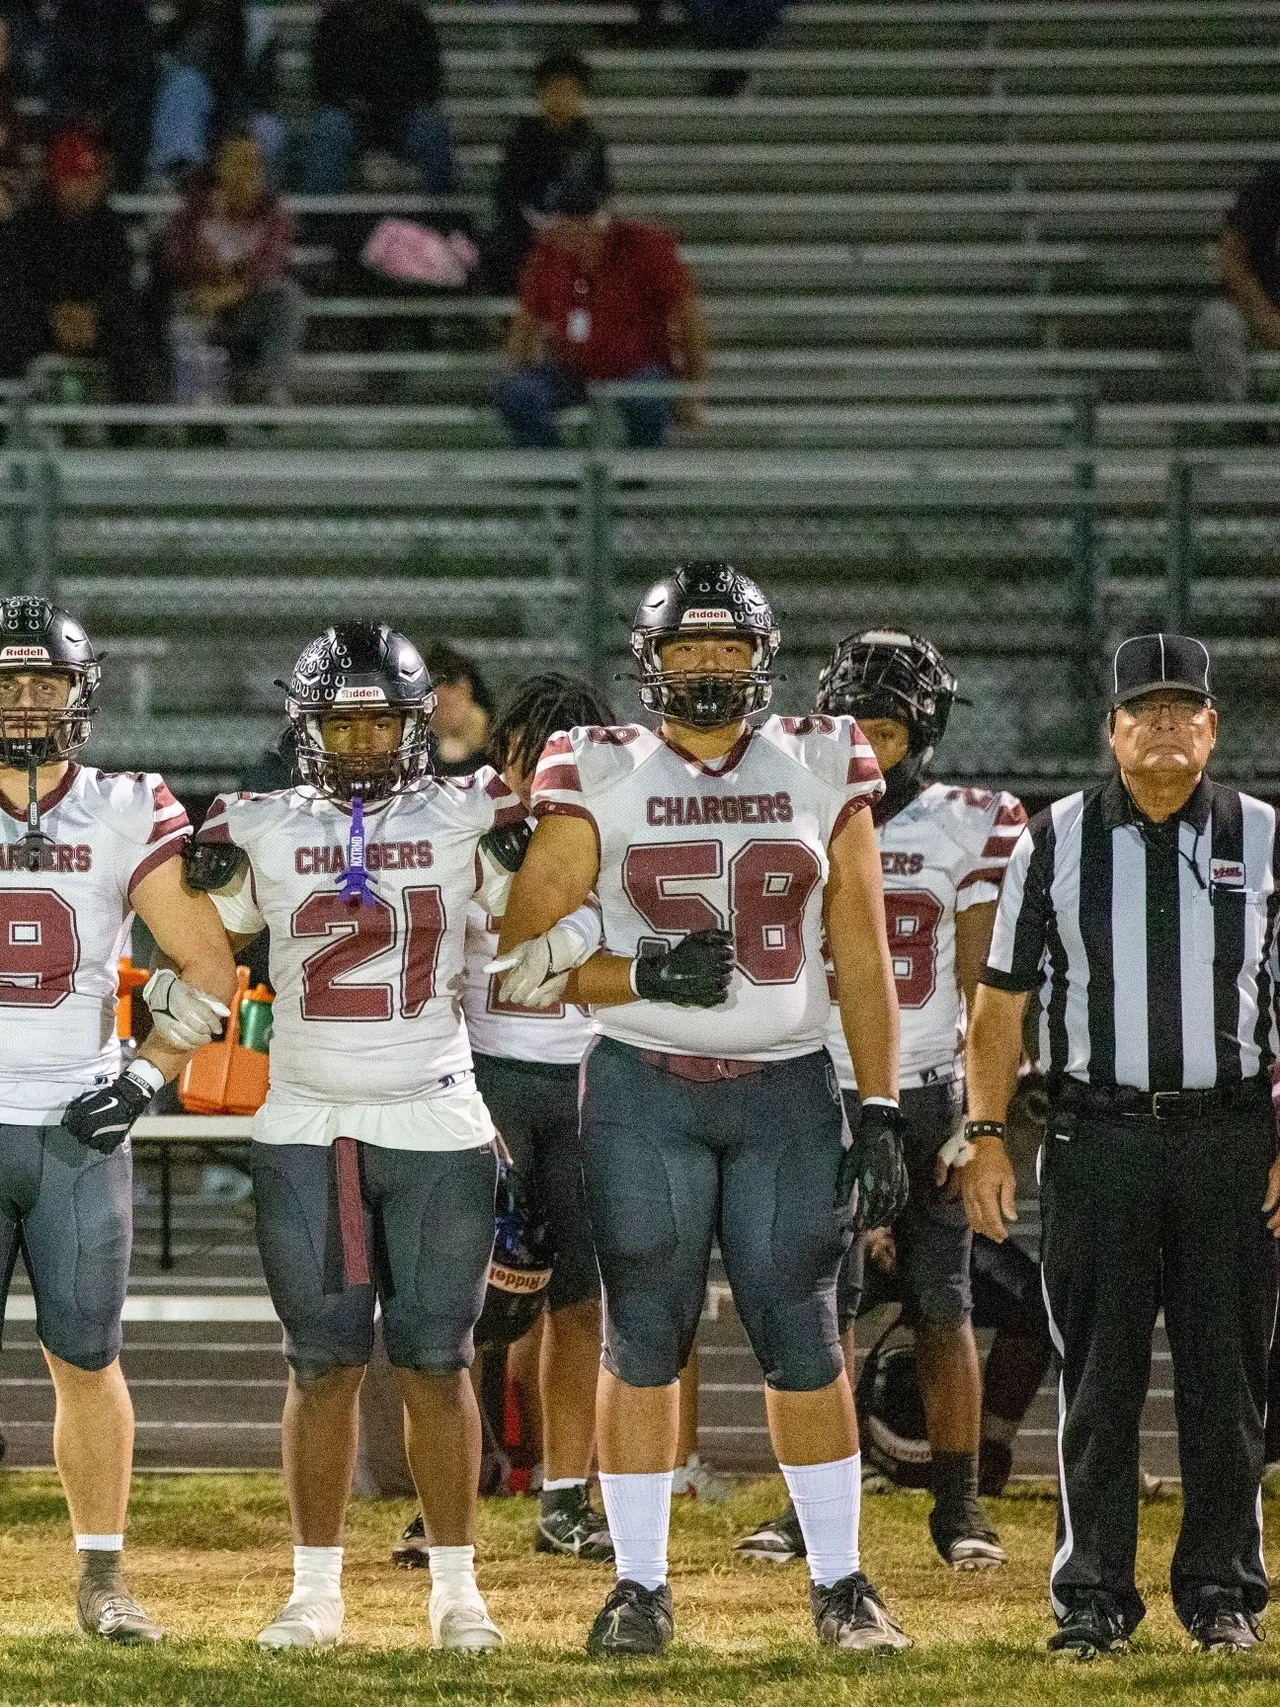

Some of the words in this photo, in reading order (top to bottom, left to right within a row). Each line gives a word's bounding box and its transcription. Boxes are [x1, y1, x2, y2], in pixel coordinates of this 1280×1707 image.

[687, 610, 727, 619] Riddell
[5, 648, 44, 657] Riddell
[341, 689, 379, 698] Riddell
[646, 791, 794, 827] CHARGERS
[294, 839, 435, 876] CHAGERS
[350, 836, 363, 866] NXTRND
[621, 838, 822, 986] 58
[290, 884, 447, 1022] 21
[488, 1266, 541, 1290] Riddel
